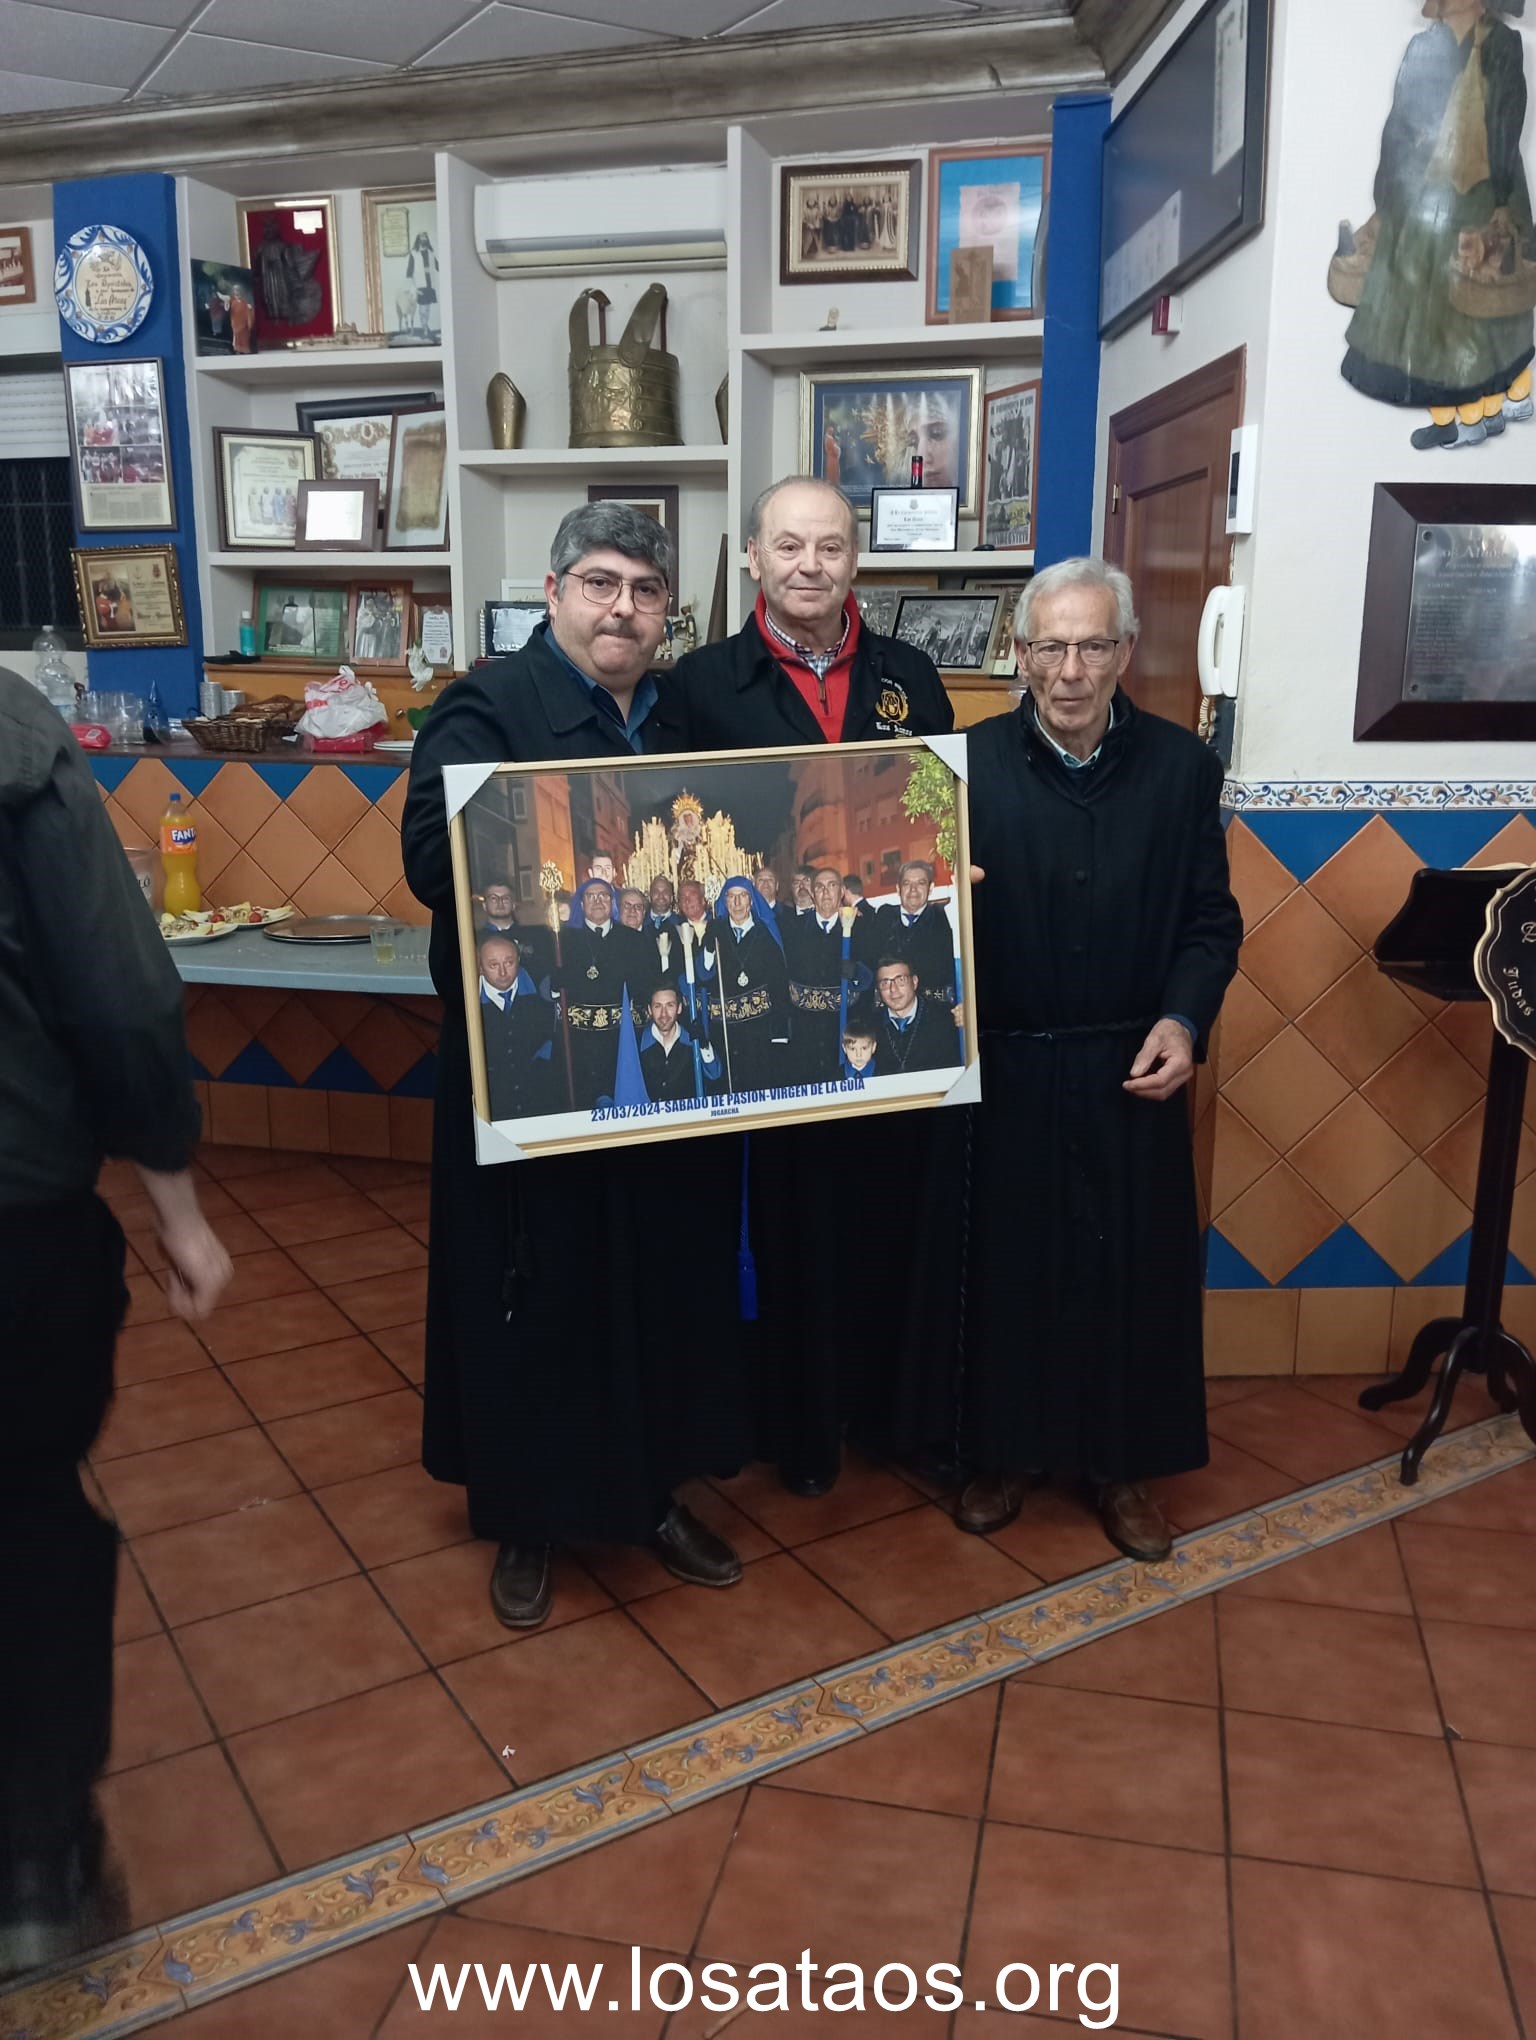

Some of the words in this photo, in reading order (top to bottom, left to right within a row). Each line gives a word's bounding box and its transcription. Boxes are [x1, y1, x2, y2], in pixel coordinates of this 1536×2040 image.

[711, 1094, 725, 1107] DE
[811, 1082, 823, 1096] DE
[826, 1081, 838, 1094] LA
